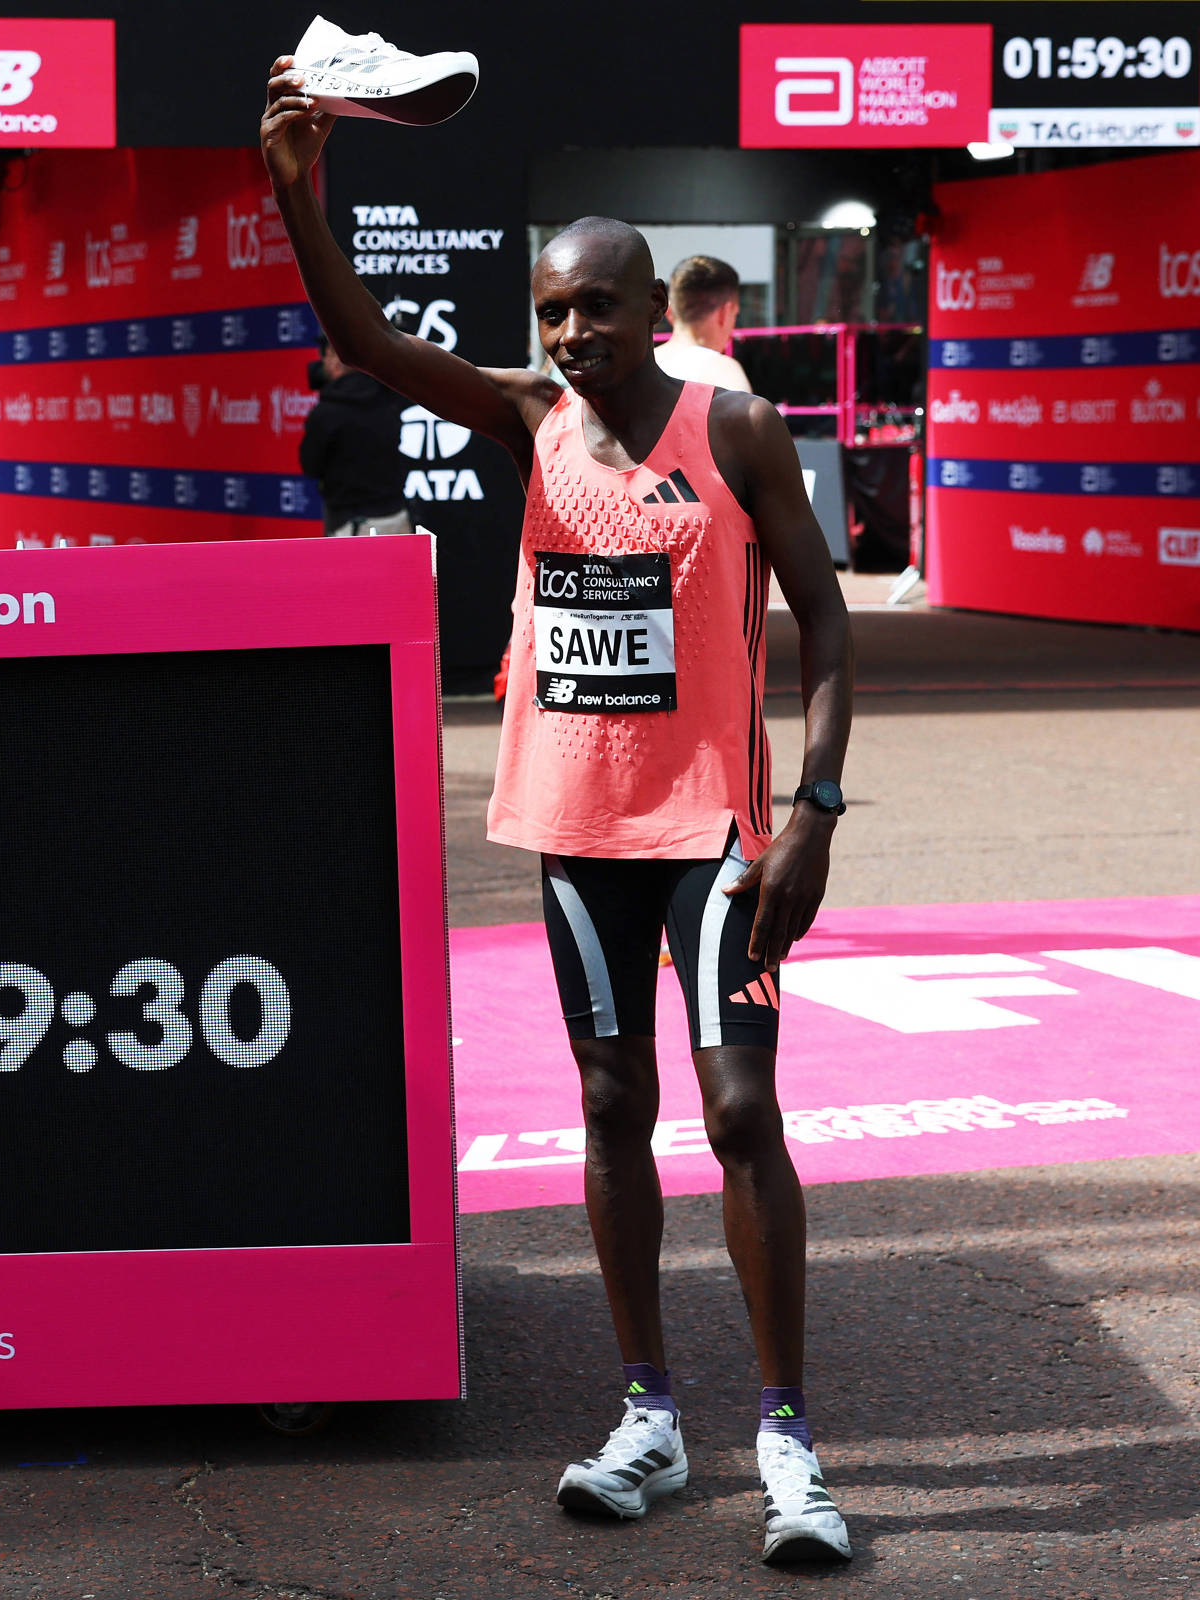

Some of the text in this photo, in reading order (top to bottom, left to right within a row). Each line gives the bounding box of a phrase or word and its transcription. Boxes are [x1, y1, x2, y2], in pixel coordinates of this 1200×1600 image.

[860, 57, 928, 74] ABBOTT
[1003, 36, 1192, 79] 01:59:30
[859, 76, 924, 92] WORLD
[859, 92, 957, 108] MARATHON
[859, 109, 928, 125] MAJORS
[352, 205, 420, 227] TATA
[352, 229, 504, 251] CONSULTANCY
[403, 468, 484, 500] ATA
[582, 563, 613, 575] TATA
[539, 561, 579, 599] tcs
[583, 575, 660, 588] CONSULTANCY
[582, 589, 630, 601] SERVICES
[550, 626, 650, 667] SAWE
[577, 693, 661, 706] new balance
